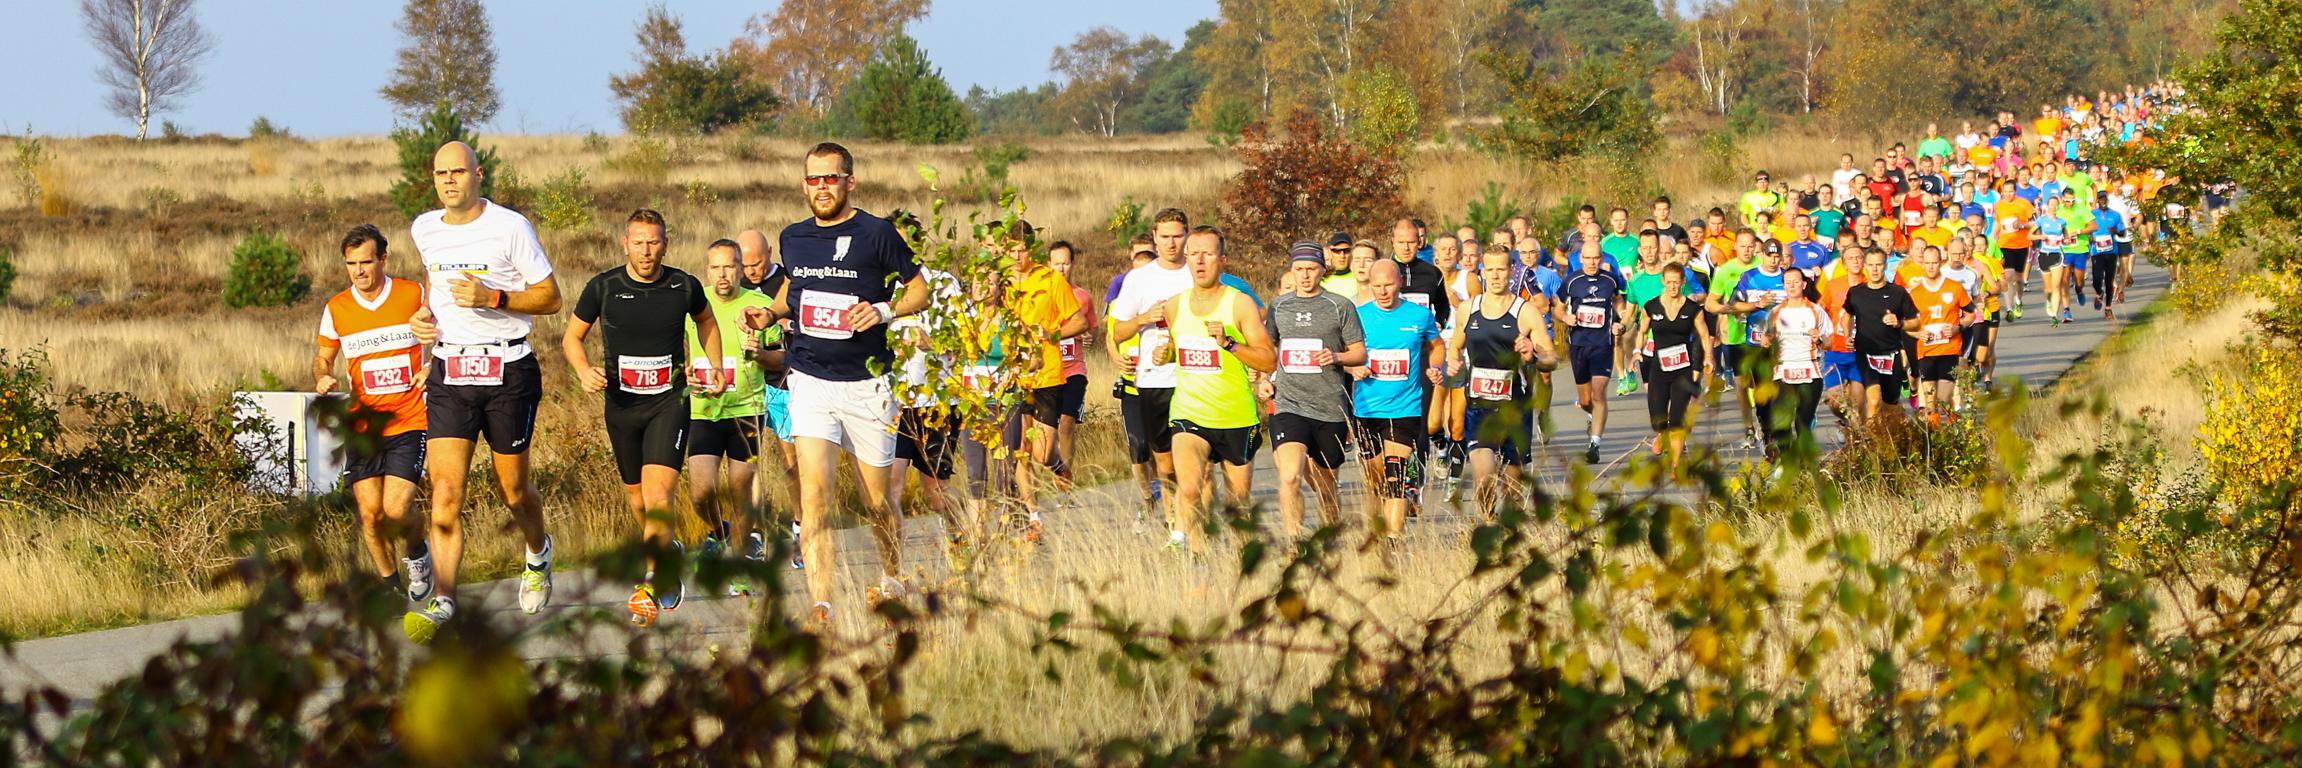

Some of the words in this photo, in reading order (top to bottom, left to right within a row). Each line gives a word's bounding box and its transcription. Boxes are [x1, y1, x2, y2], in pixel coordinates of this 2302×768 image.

[812, 307, 841, 328] 954
[459, 356, 491, 376] 1150
[1183, 349, 1213, 366] 1388
[1288, 350, 1311, 365] 626
[1377, 360, 1401, 375] 1371
[372, 368, 404, 387] 1292
[634, 369, 659, 386] 718
[1480, 379, 1505, 395] 1247
